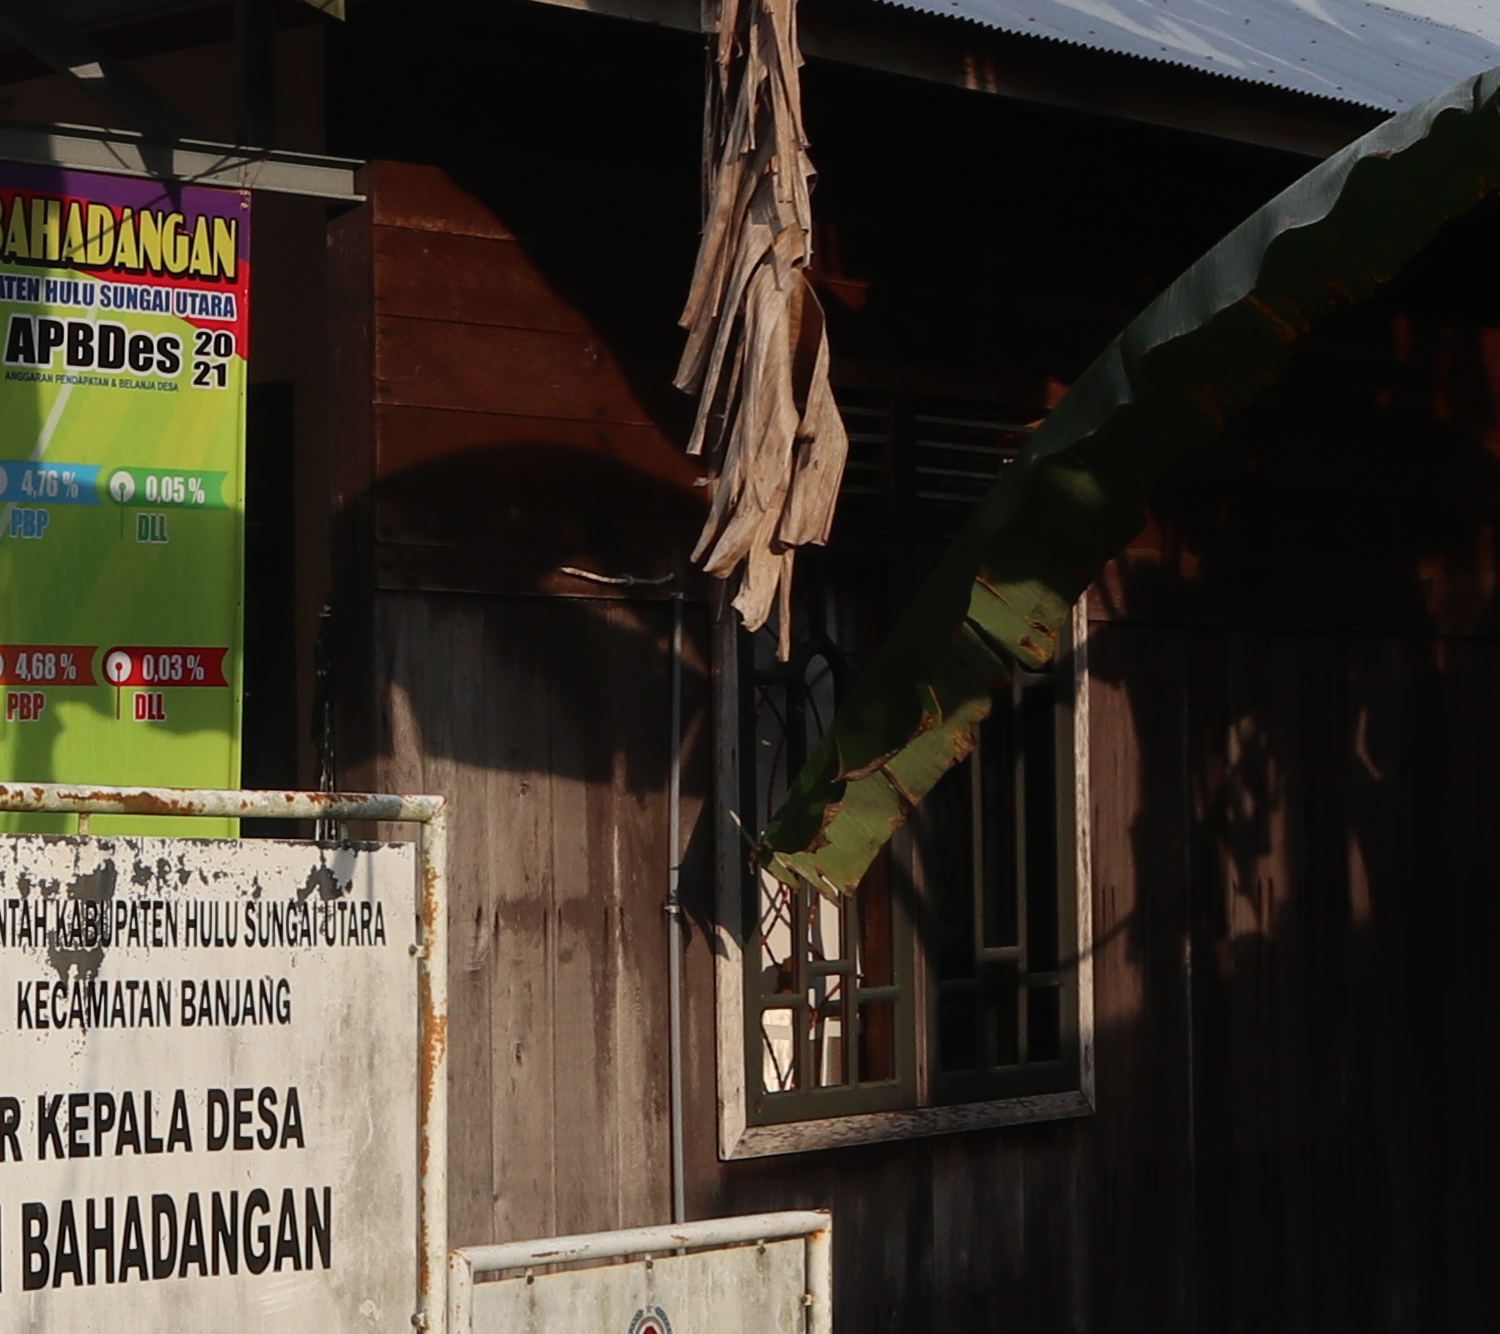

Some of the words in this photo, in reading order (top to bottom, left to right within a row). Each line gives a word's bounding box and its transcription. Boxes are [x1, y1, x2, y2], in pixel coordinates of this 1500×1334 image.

[45, 279, 95, 307] HULU
[100, 285, 171, 313] SUNGAI
[174, 292, 235, 319] UTARA
[4, 317, 181, 373] APBDes
[194, 331, 232, 357] 20
[4, 371, 53, 383] ANGGARAN
[55, 374, 109, 387] PENDAPATAN
[119, 379, 156, 390] BELANJA
[158, 381, 179, 391] DESA
[192, 361, 227, 387] 21
[10, 509, 49, 537] PBP
[137, 513, 168, 543] DLL
[6, 692, 45, 723] PBP
[133, 693, 166, 722] DLL
[53, 898, 178, 948] KABUPATEN
[185, 900, 238, 947] HULU
[244, 900, 318, 947] SUNGAI
[324, 900, 387, 947] UTARA
[17, 980, 171, 1031] KECAMATAN
[180, 981, 291, 1026] BANJANG
[37, 1089, 194, 1160] KEPALA
[207, 1086, 305, 1151] DESA
[21, 1187, 332, 1292] BAHADANGAN
